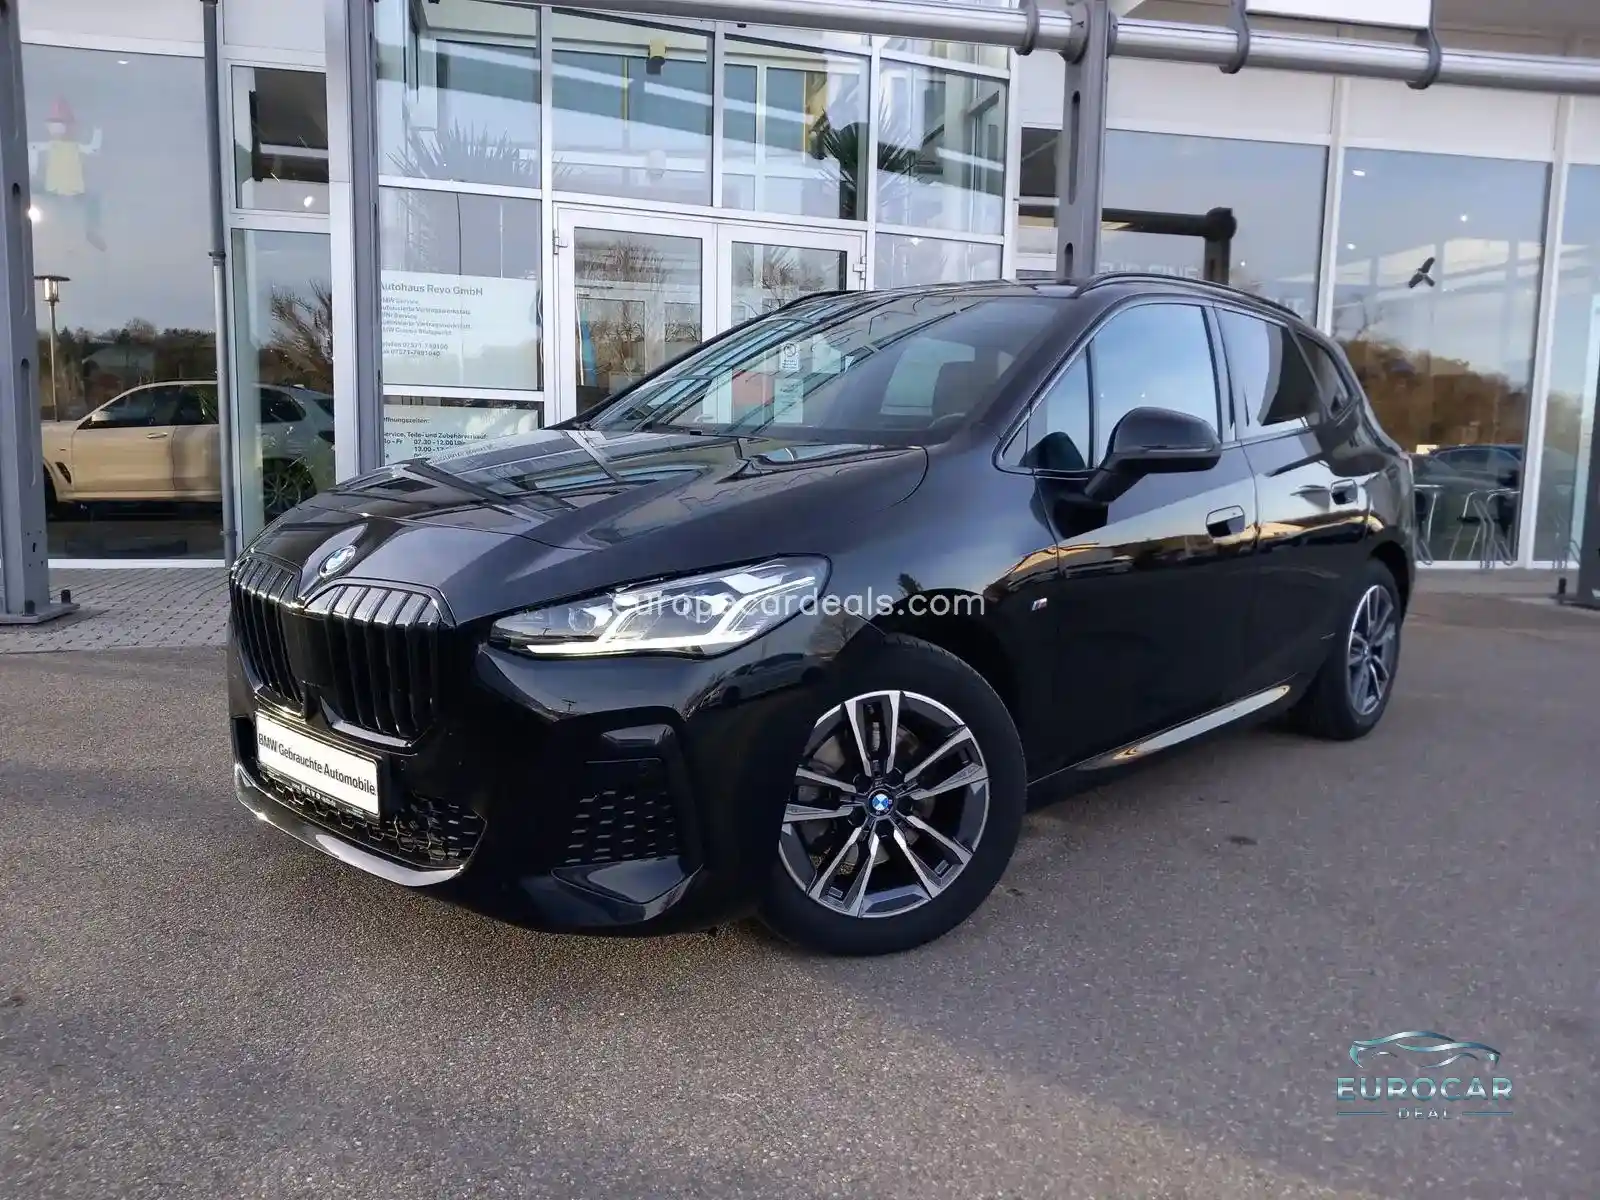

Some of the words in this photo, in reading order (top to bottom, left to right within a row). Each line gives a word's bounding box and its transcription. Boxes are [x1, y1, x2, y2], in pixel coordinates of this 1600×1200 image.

[427, 285, 450, 294] Revo
[453, 286, 483, 296] GmbH
[258, 733, 277, 753] BMW
[278, 743, 323, 774] Gebrauchte
